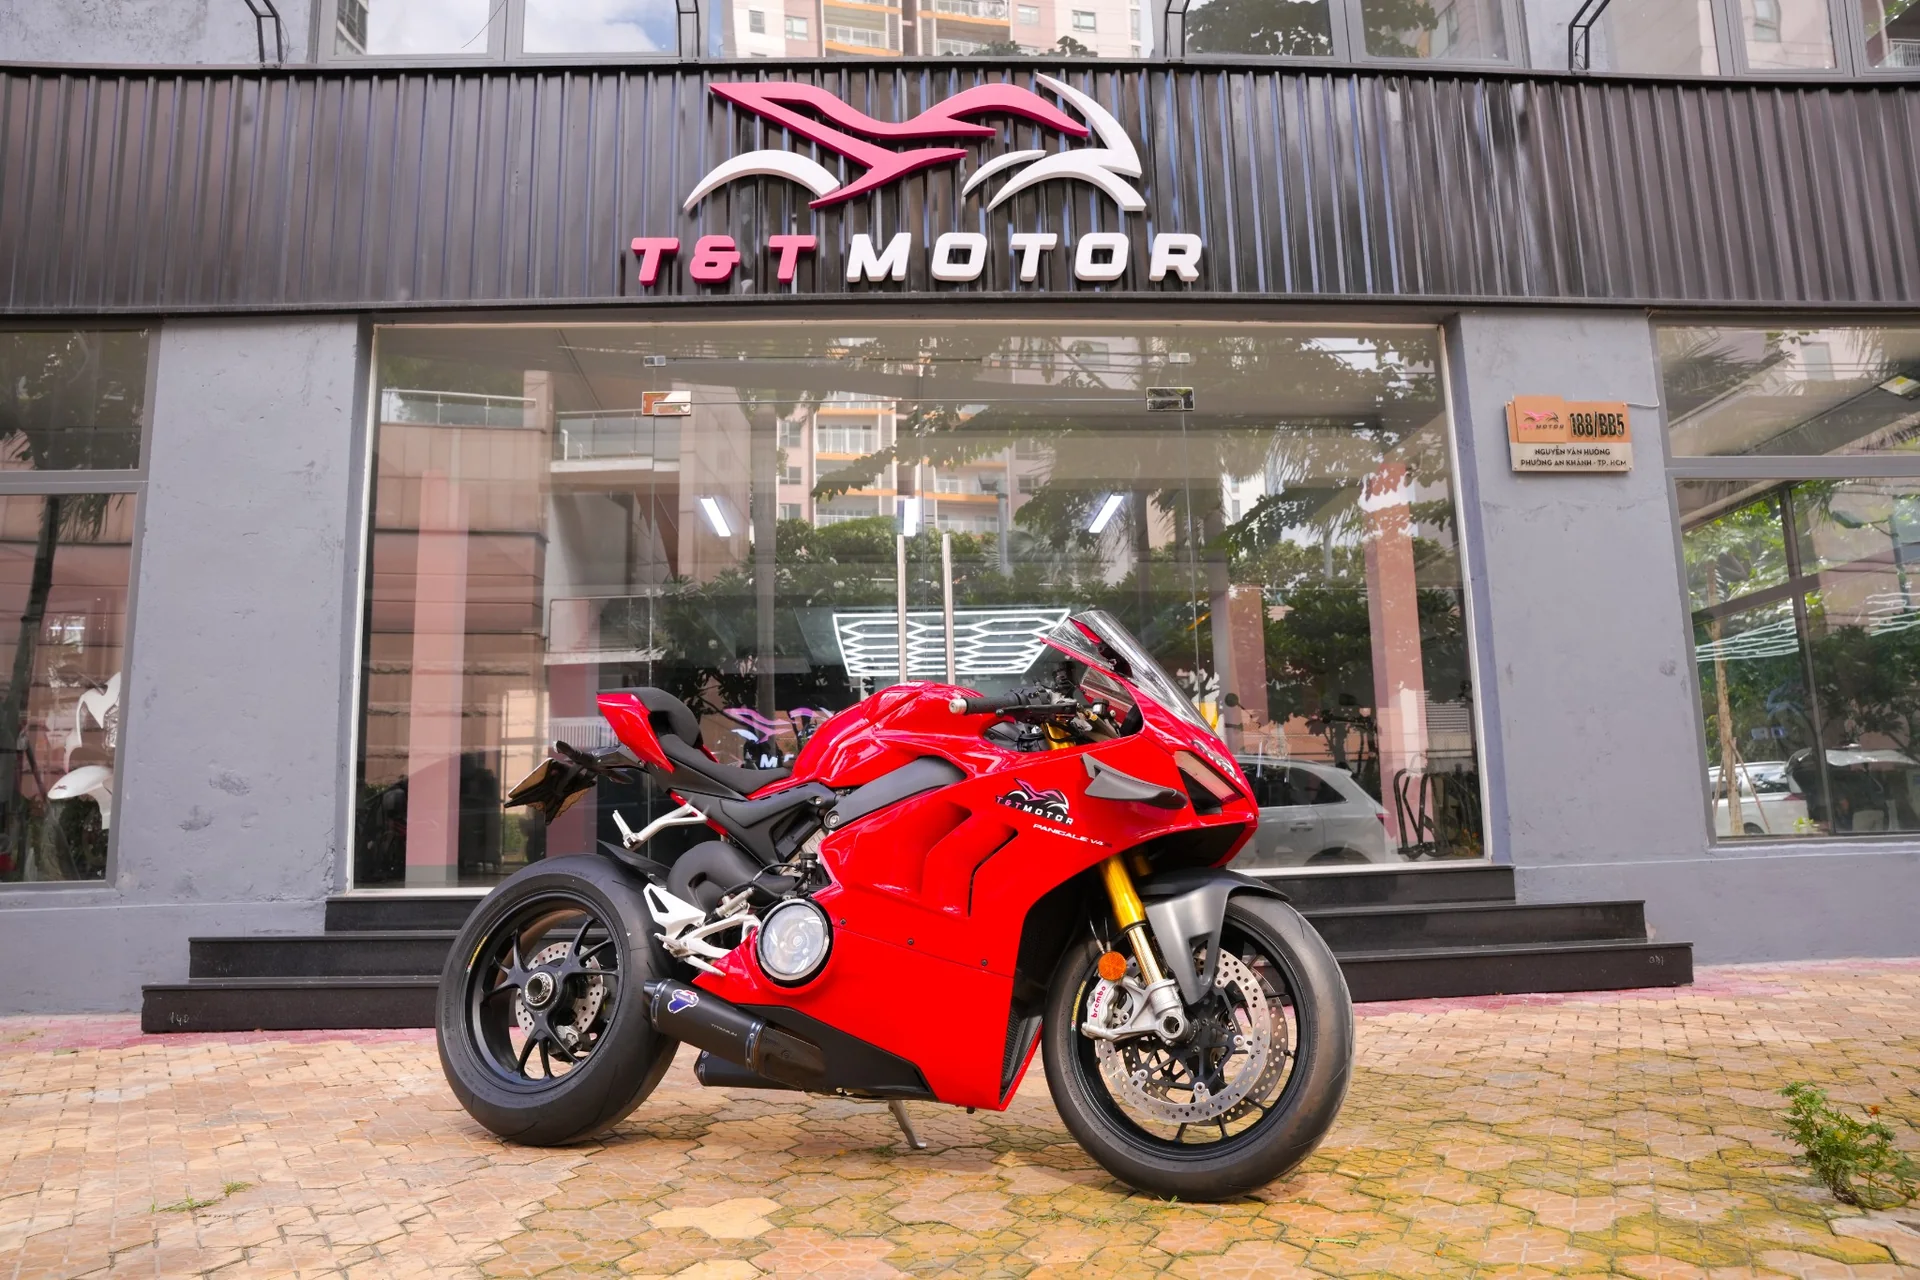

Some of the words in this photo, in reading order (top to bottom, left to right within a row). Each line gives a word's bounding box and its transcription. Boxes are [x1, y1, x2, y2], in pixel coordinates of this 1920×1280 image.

[846, 232, 1202, 282] MOTOR
[1569, 411, 1625, 438] 188/BB5
[1022, 804, 1074, 825] MOTOR
[1032, 823, 1089, 842] PANIGALE
[1091, 985, 1107, 1018] brembo
